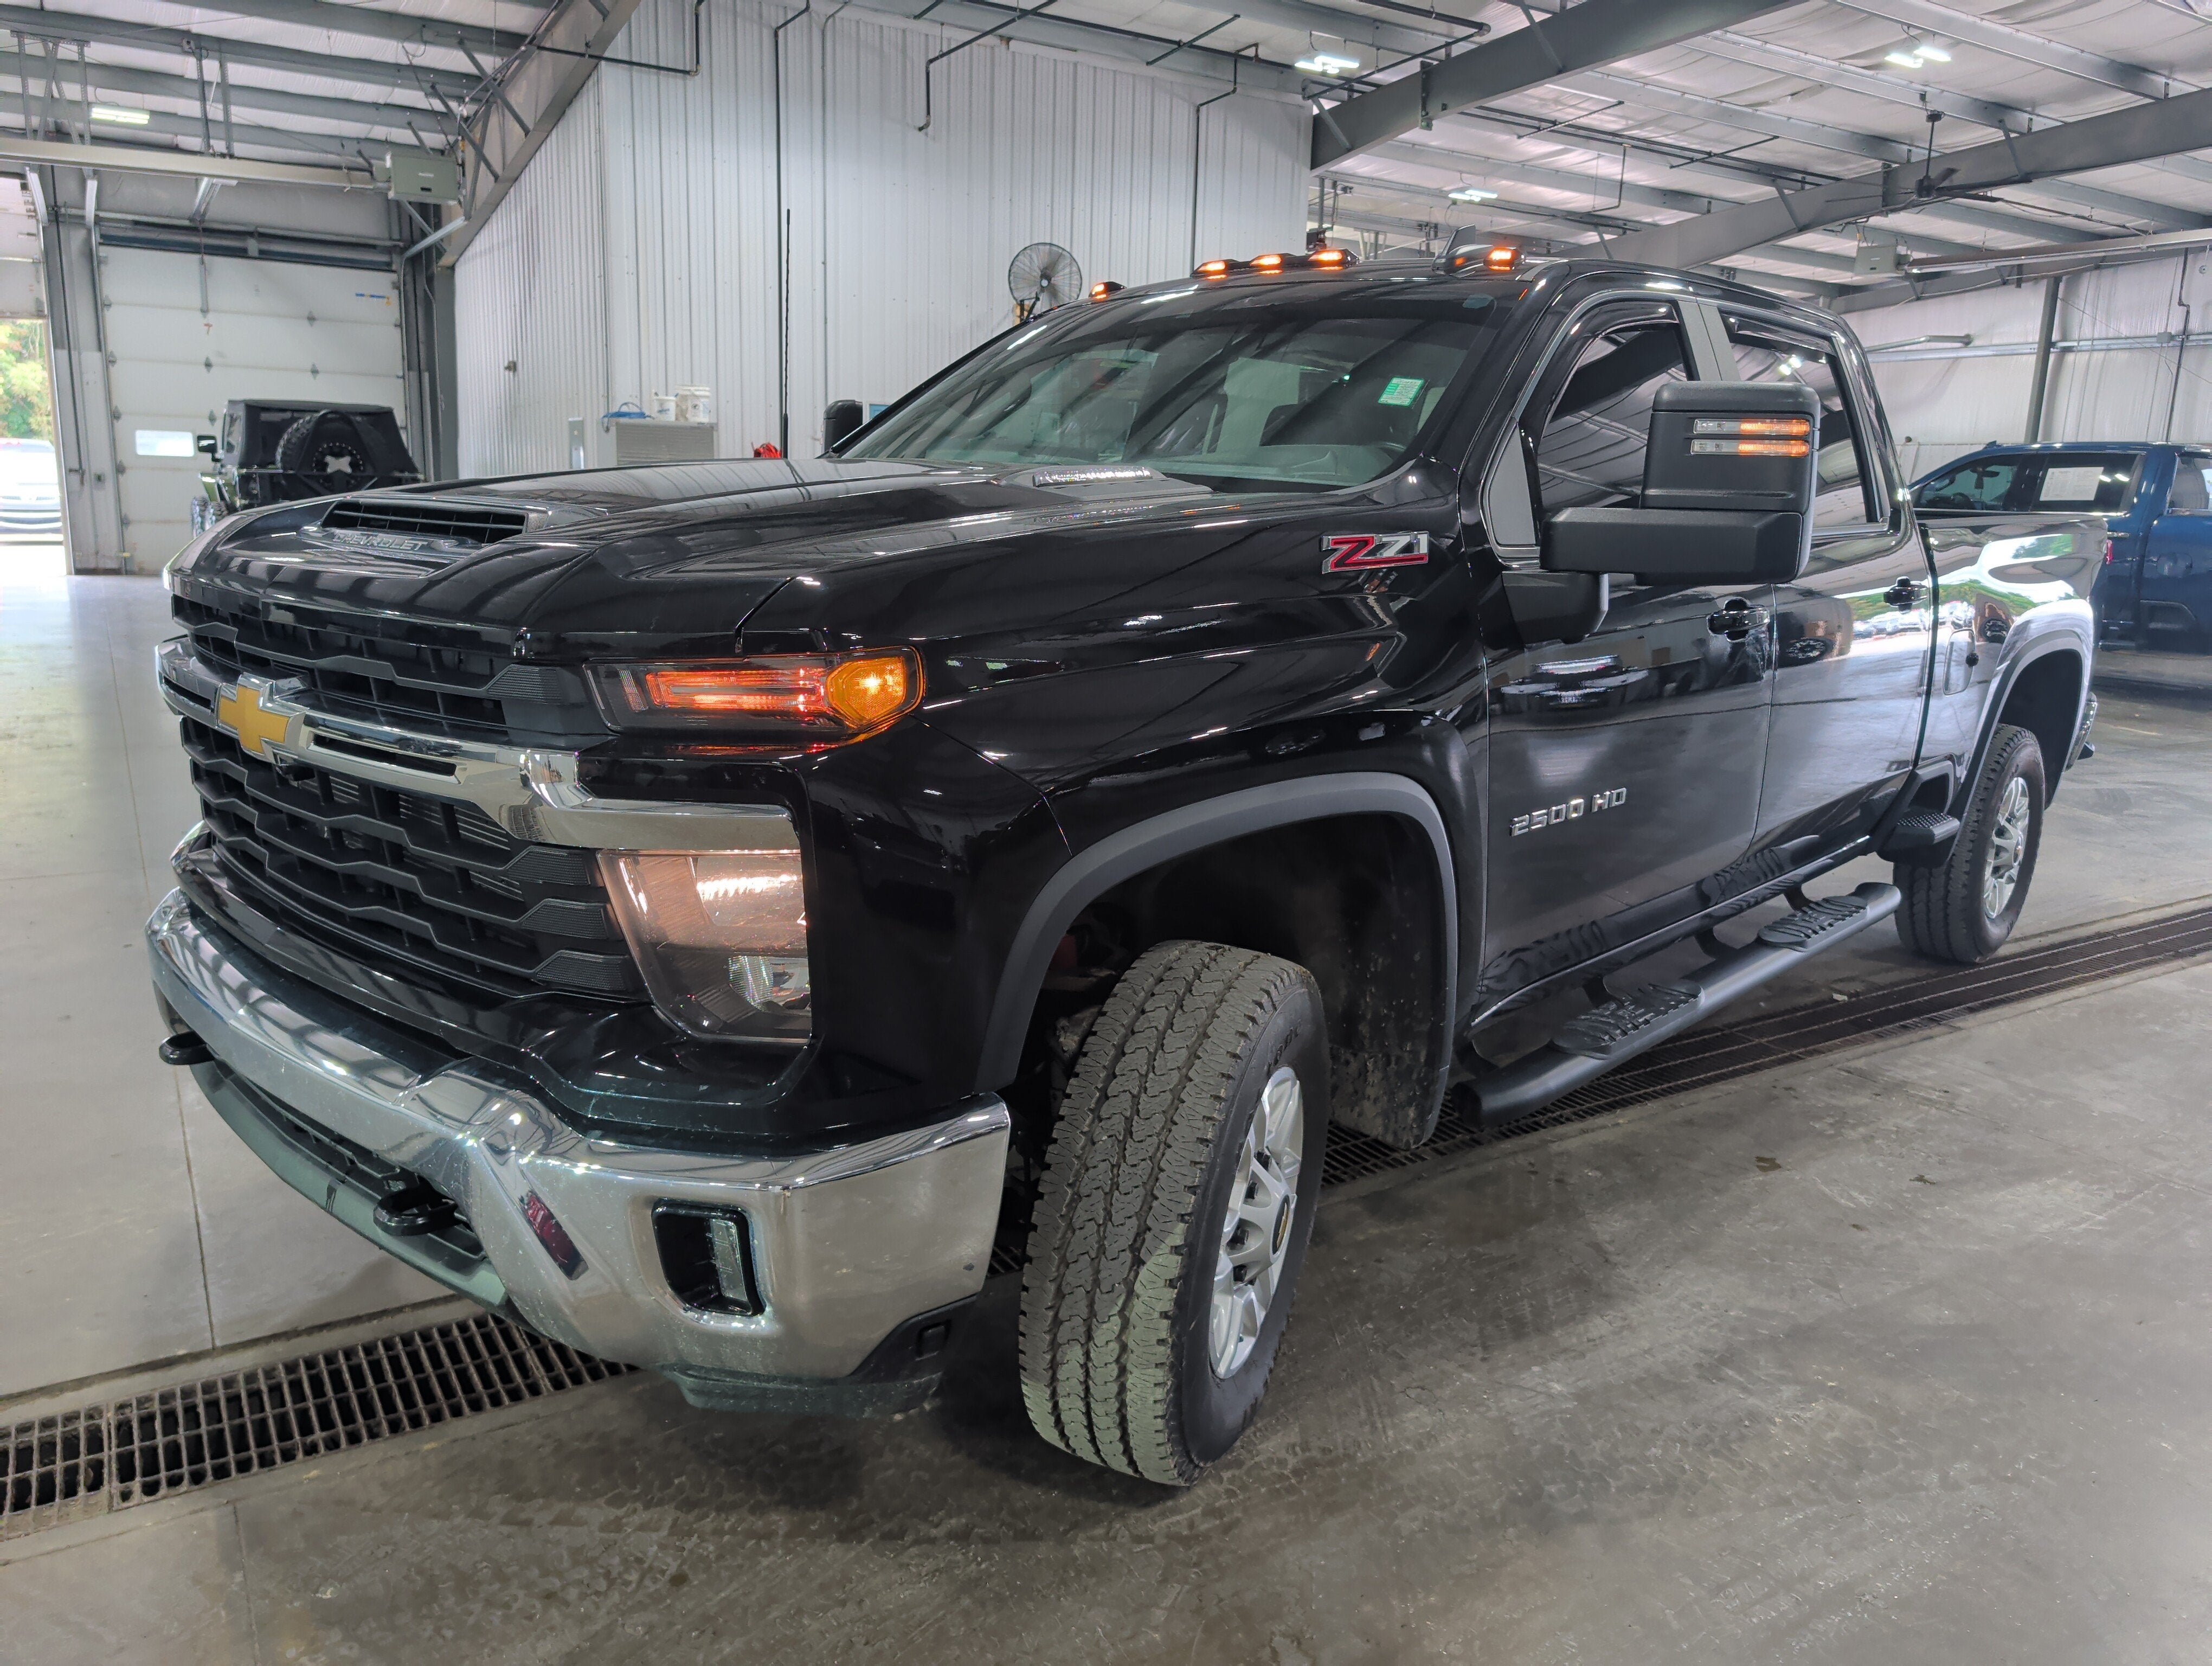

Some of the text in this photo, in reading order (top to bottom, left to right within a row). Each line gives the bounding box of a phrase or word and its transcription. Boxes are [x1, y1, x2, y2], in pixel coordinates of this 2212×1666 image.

[332, 531, 428, 551] CHEVROLET
[1321, 531, 1429, 574] Z71
[1510, 787, 1627, 837] 2500 HD
